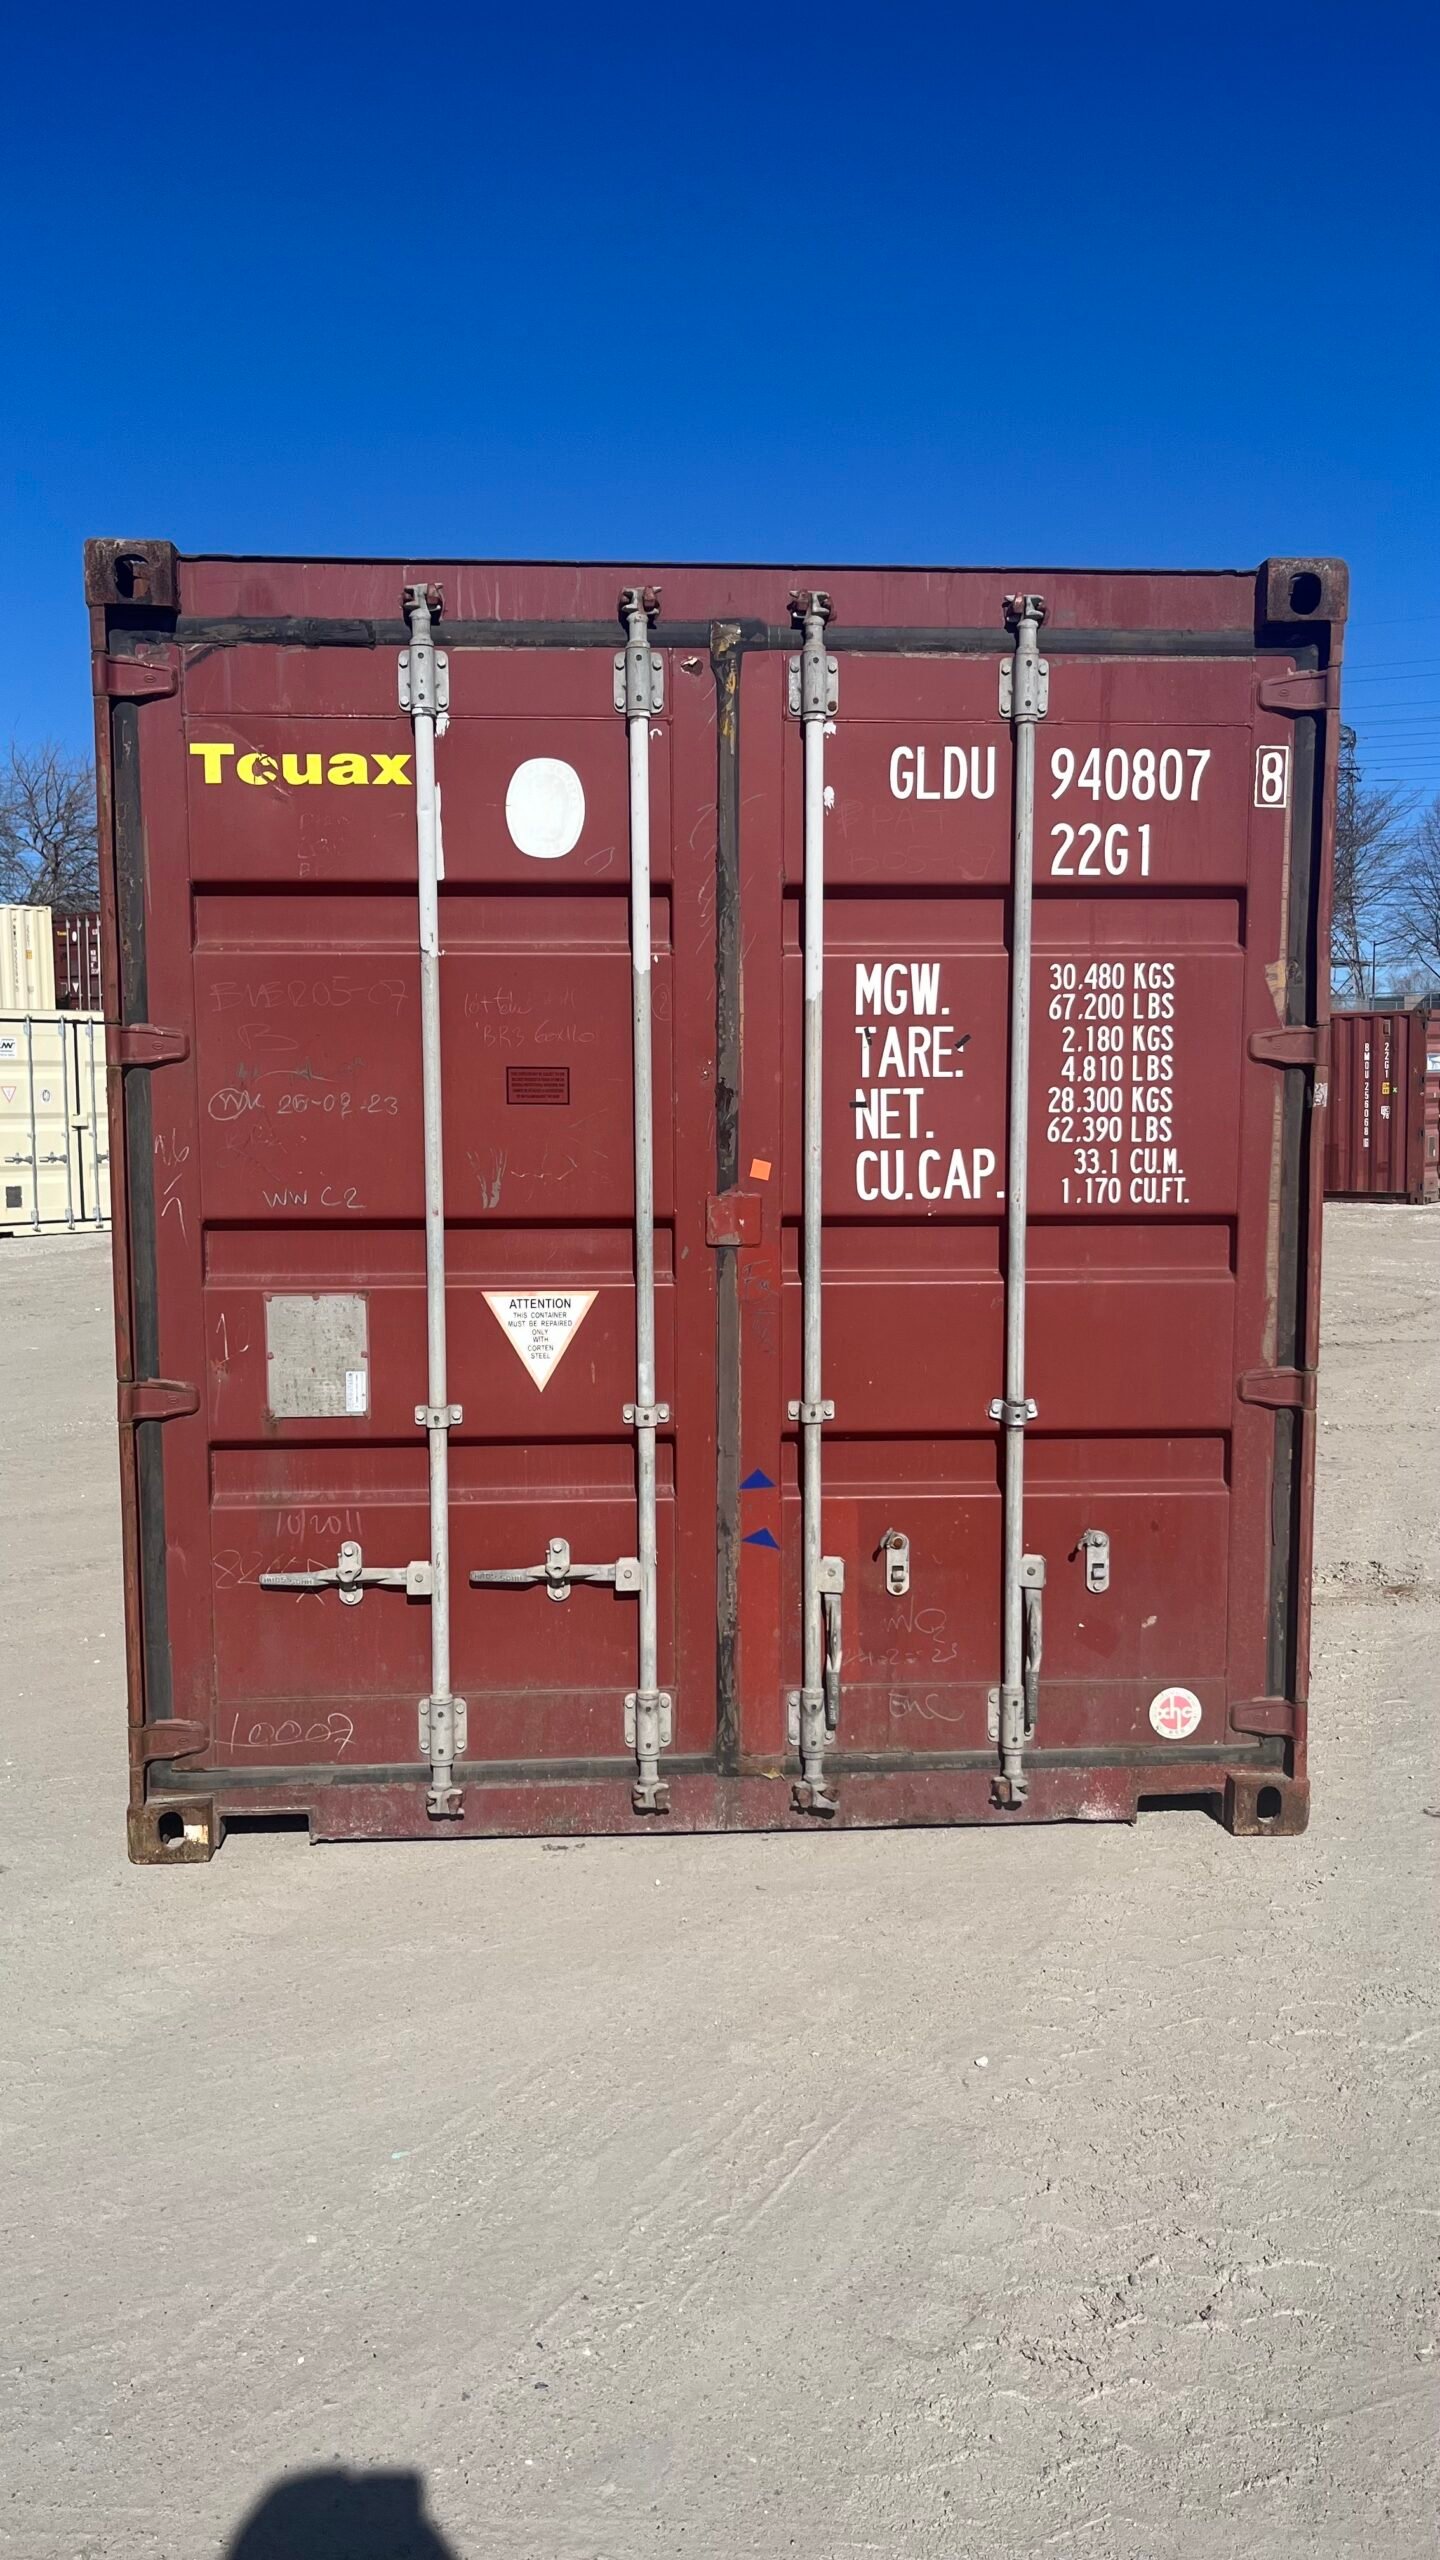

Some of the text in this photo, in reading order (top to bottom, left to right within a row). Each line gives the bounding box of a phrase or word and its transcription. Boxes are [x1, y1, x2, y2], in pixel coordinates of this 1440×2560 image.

[889, 745, 1284, 803] GLDU 940807 8
[1050, 822, 1150, 877] 22G1
[855, 962, 1175, 1016] MGW. 30,480 KGS
[1048, 992, 1175, 1020] 67,200 LBS
[855, 1024, 1174, 1078] TARE. 2,180 KGS
[1061, 1054, 1174, 1083] 4,810 LBS
[855, 1086, 1173, 1140] NET. 28,300 KGS
[1047, 1115, 1173, 1143] 62,390 LBS
[856, 1147, 1184, 1201] CU.CAP. 33.1 CU.M.
[1061, 1177, 1190, 1204] 1,170 CU.FT.
[509, 1298, 572, 1309] ATTENTION
